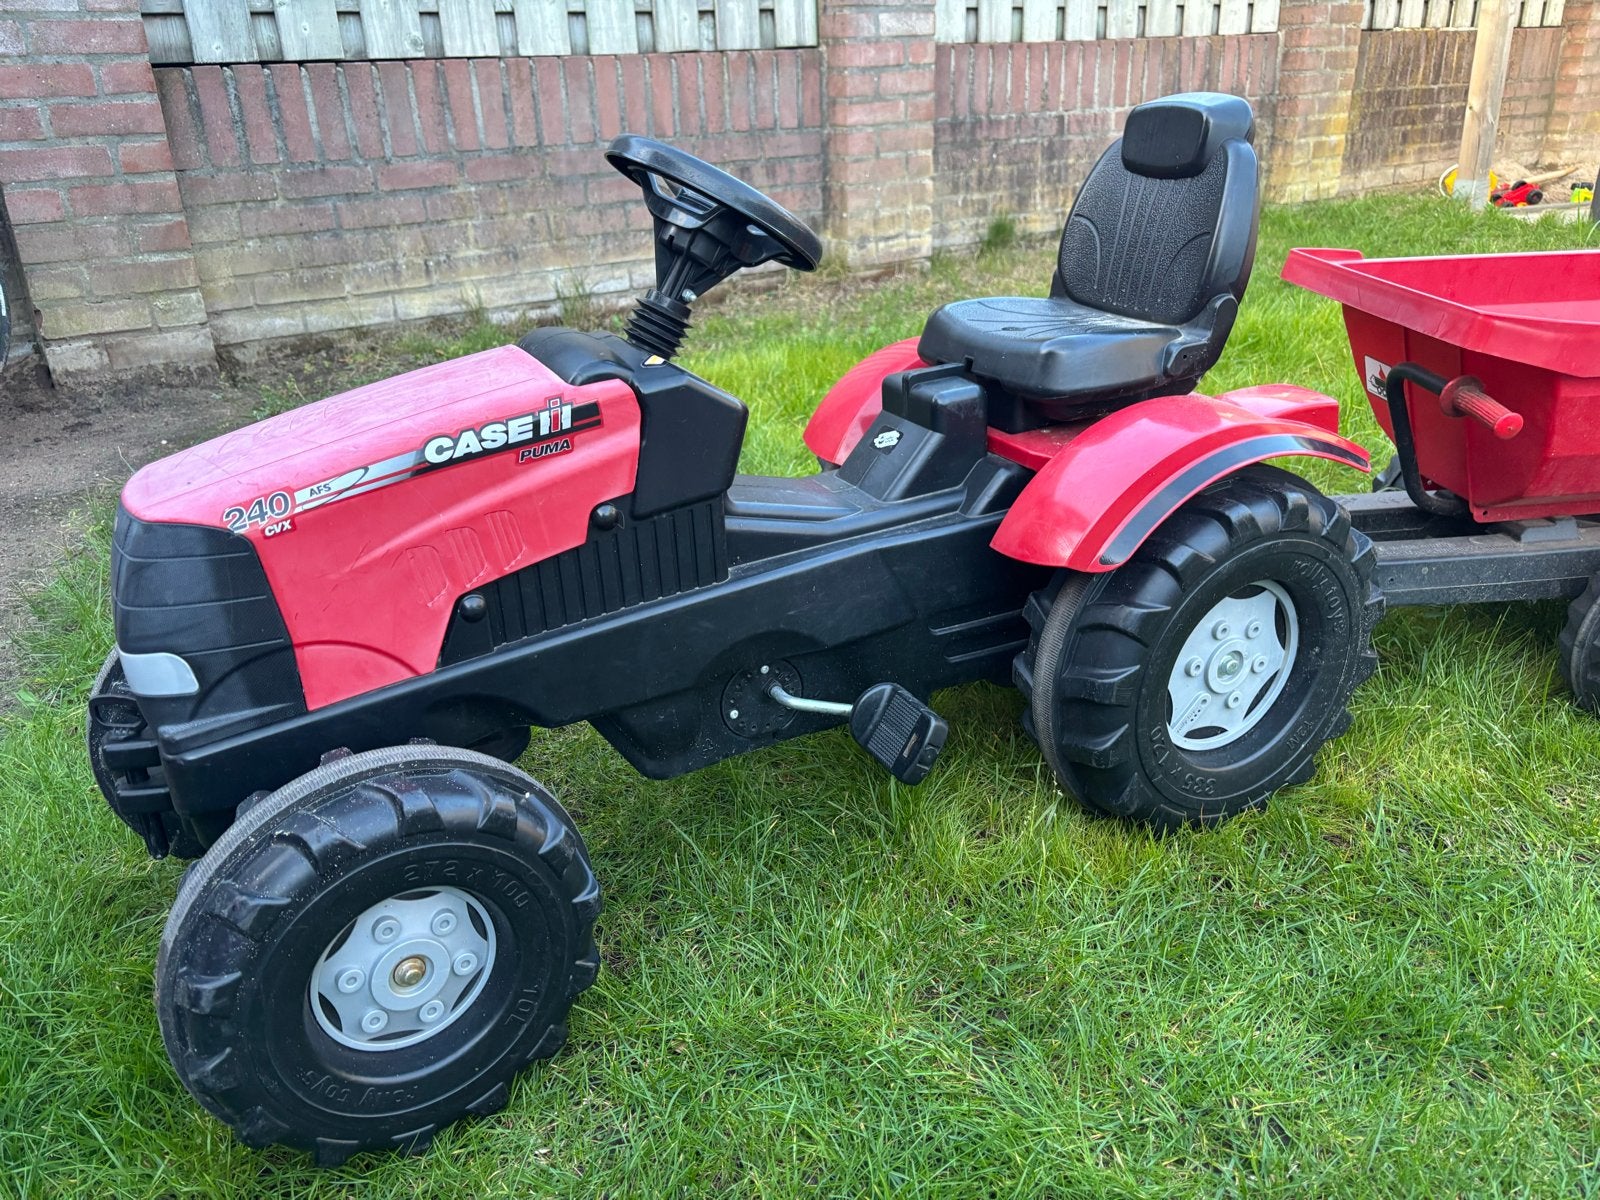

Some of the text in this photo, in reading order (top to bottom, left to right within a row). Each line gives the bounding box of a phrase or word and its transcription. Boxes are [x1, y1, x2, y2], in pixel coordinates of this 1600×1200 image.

[424, 415, 534, 465] CASE
[519, 438, 572, 463] PUMA
[309, 482, 332, 498] AFS
[223, 490, 292, 534] 240
[264, 518, 292, 537] CVX
[400, 859, 460, 882] 272
